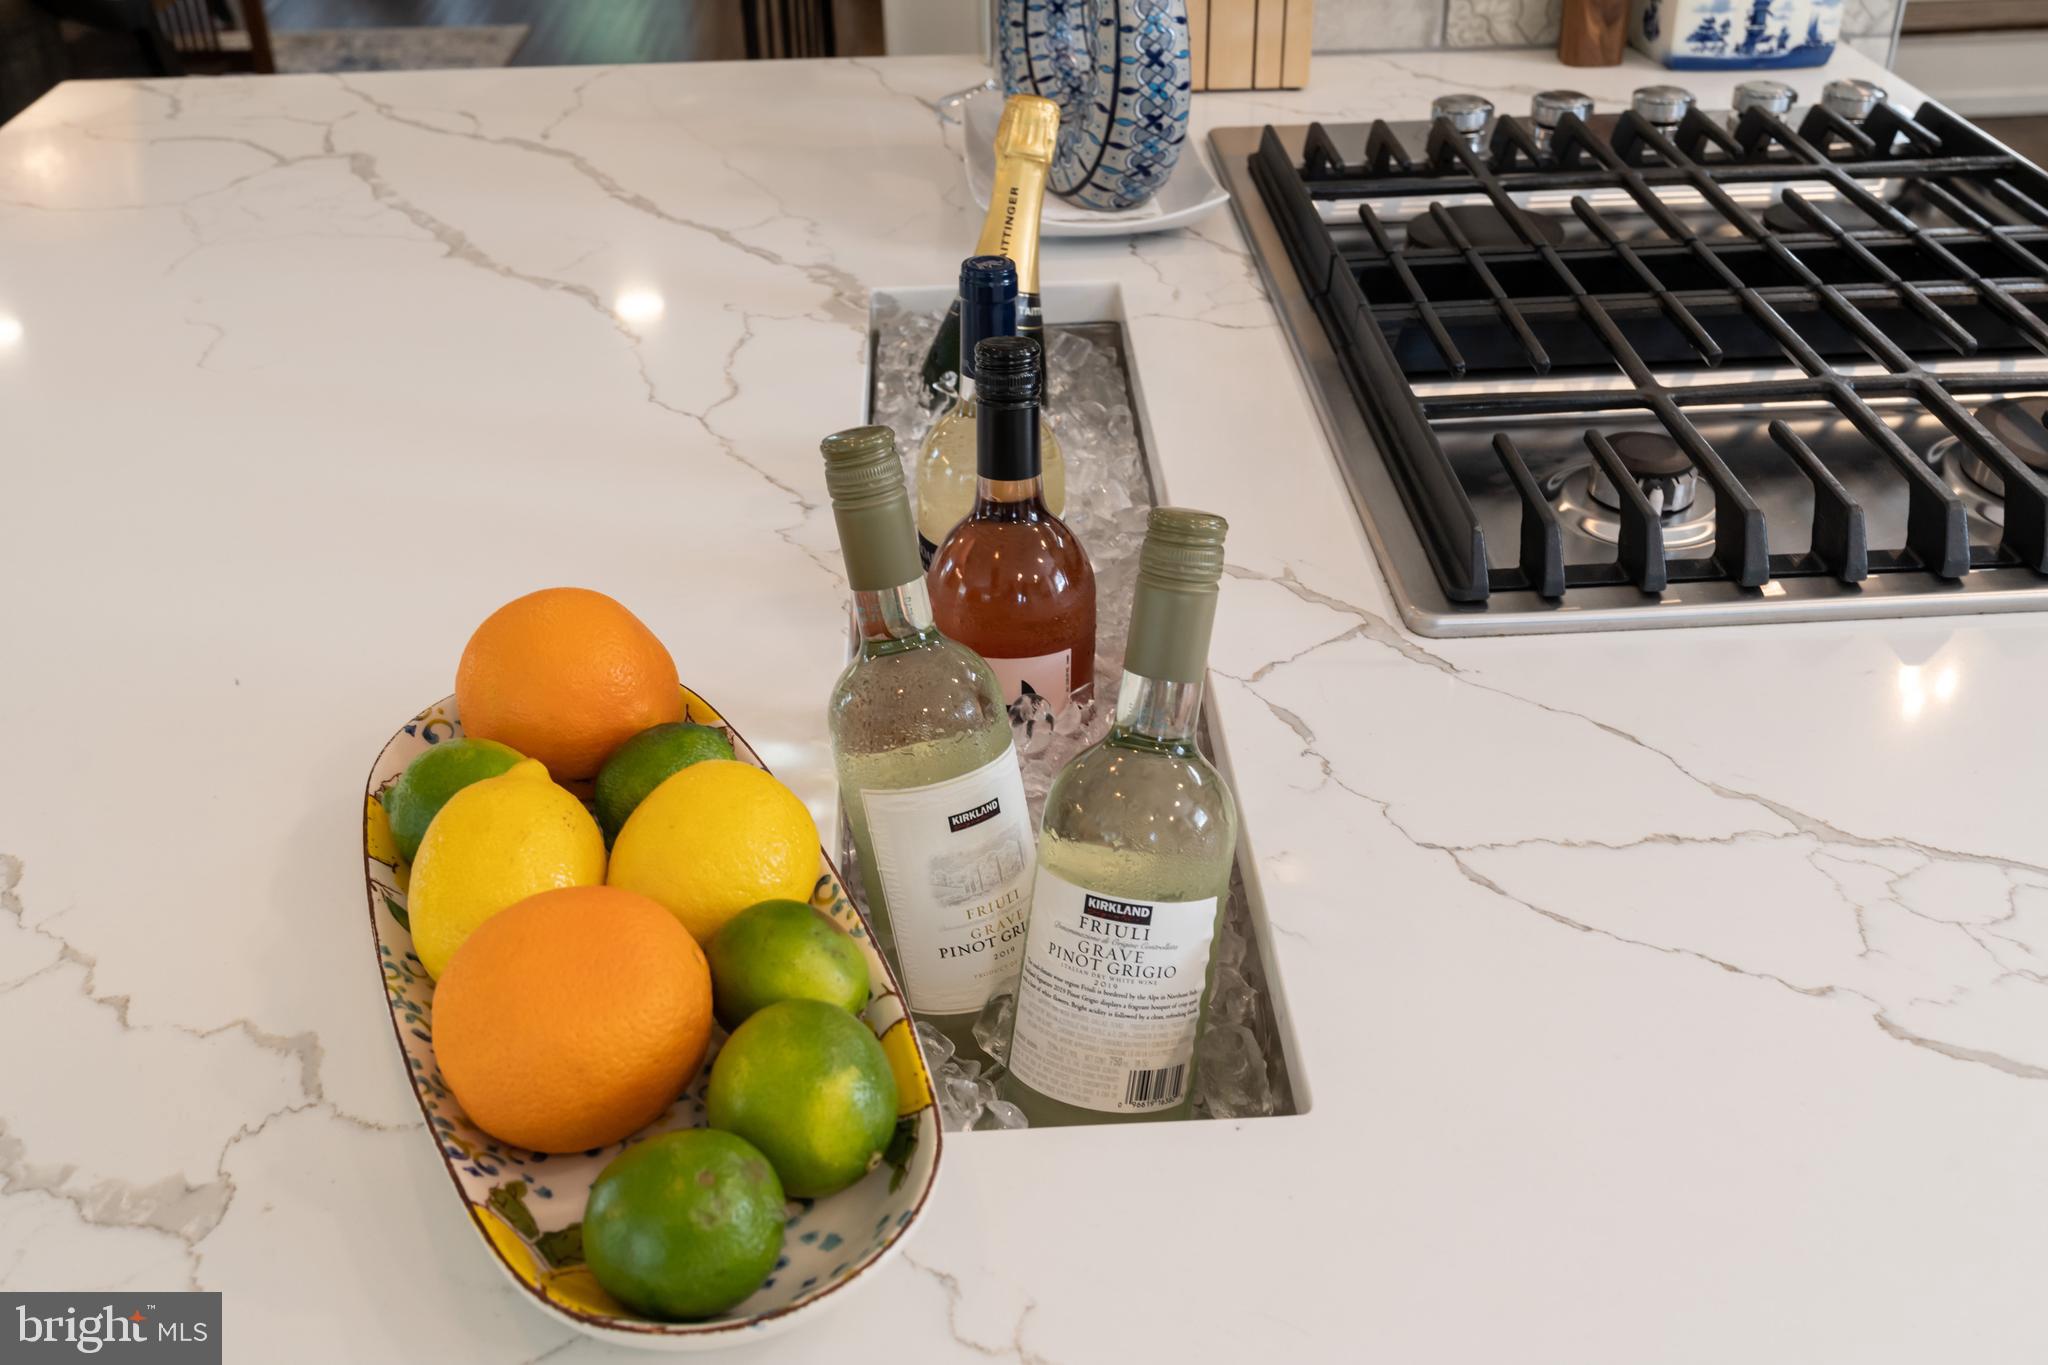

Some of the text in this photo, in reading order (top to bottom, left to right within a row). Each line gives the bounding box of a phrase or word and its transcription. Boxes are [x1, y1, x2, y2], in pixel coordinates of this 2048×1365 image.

[951, 800, 998, 826] KIRKLAND
[966, 889, 1019, 920] FRIULI
[1088, 897, 1150, 917] KIRKLAND
[970, 908, 1024, 940] GRAVE
[1079, 916, 1151, 941] FRIULI
[938, 935, 997, 959] PINOT
[1001, 921, 1026, 943] GRI
[1078, 940, 1145, 964] GRAVE
[1048, 942, 1103, 971] PINOT
[1107, 961, 1177, 979] GRIGIO
